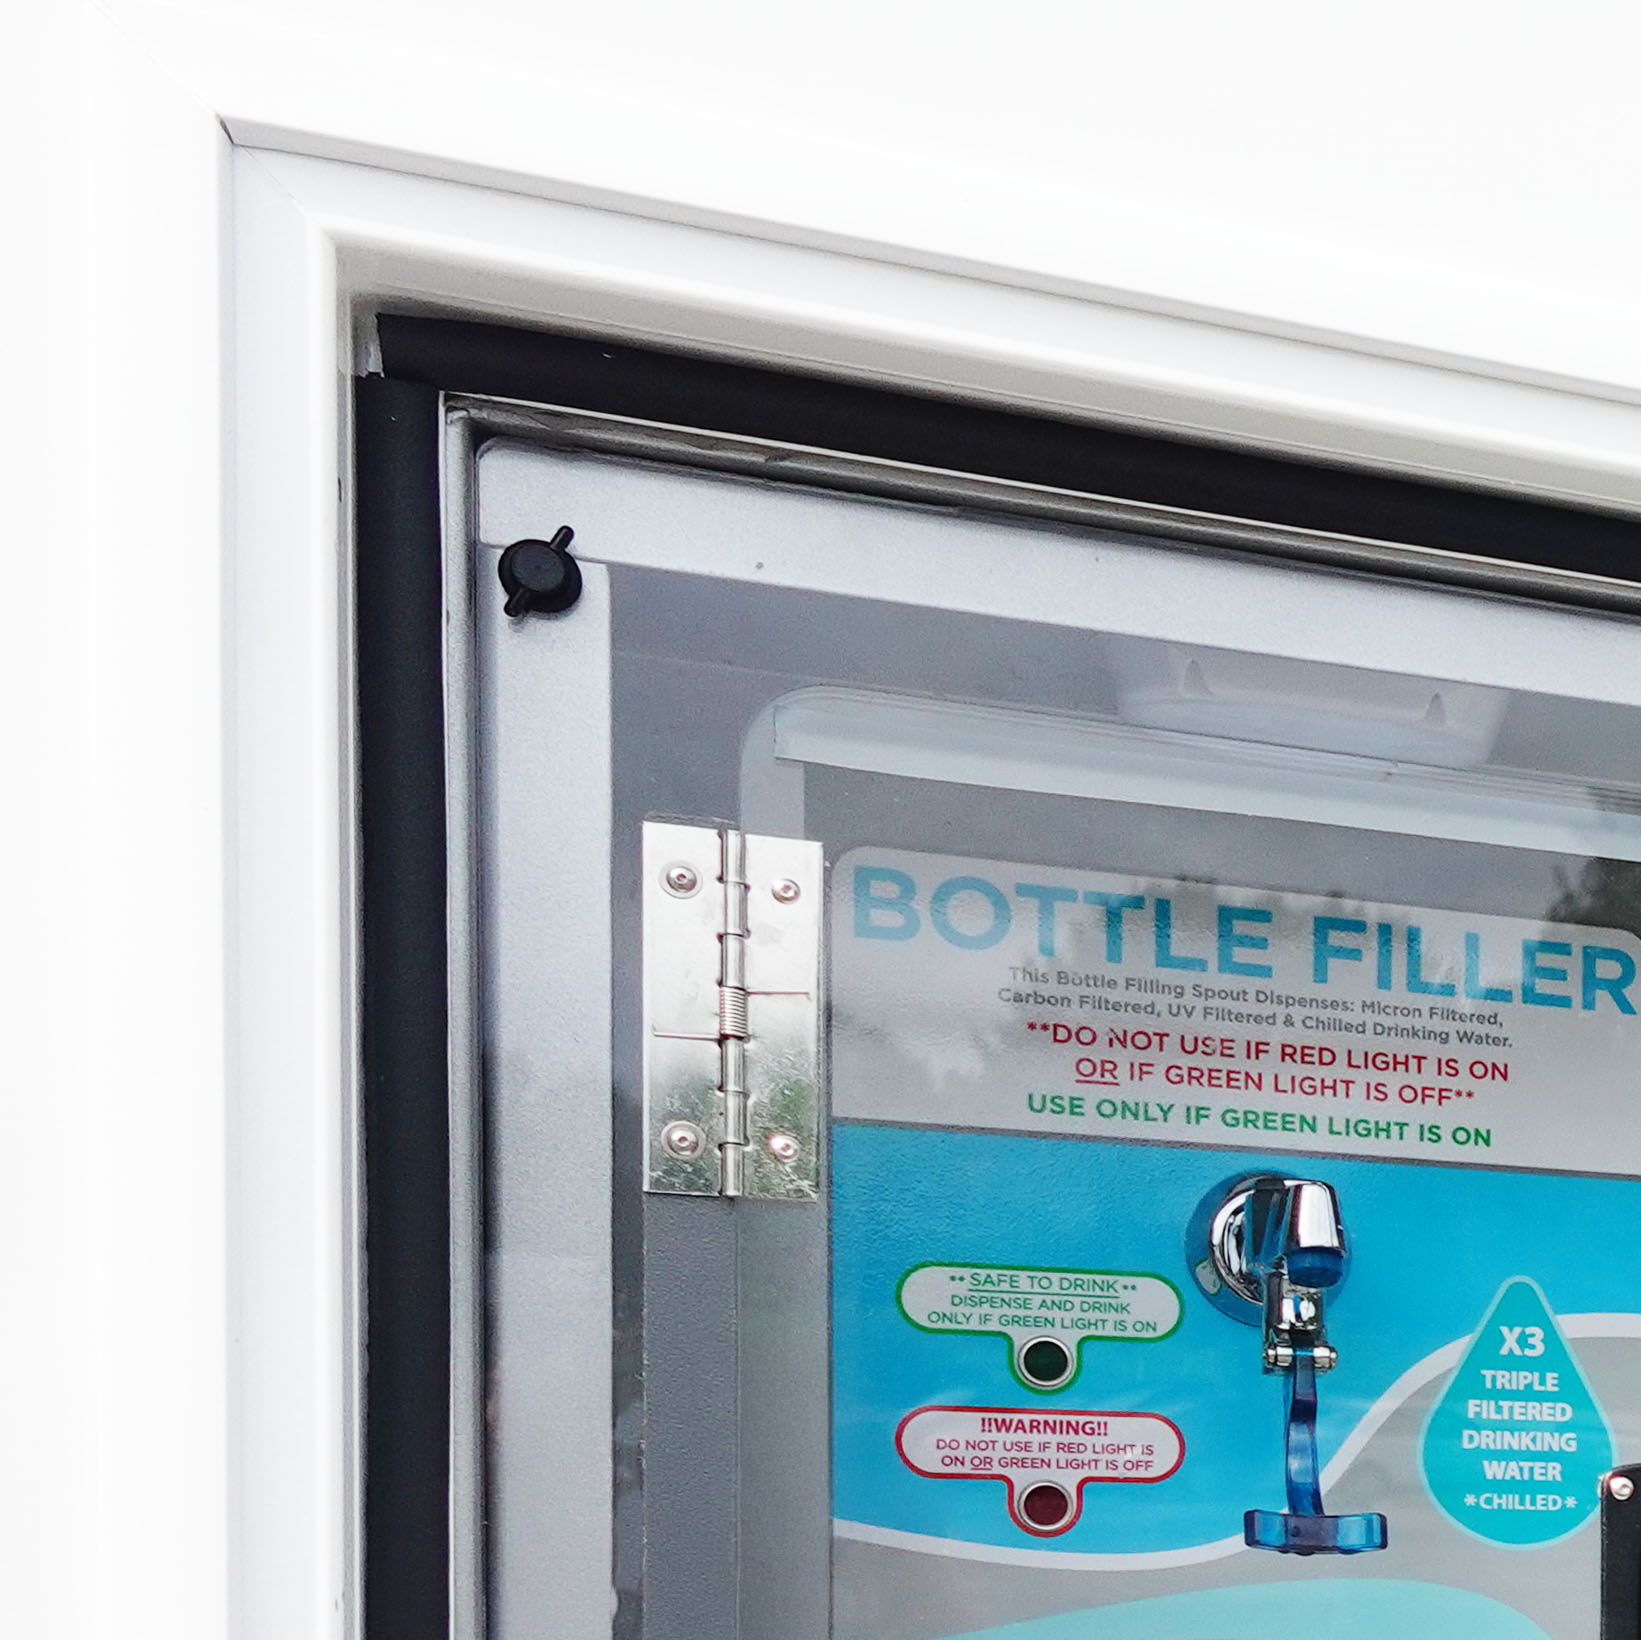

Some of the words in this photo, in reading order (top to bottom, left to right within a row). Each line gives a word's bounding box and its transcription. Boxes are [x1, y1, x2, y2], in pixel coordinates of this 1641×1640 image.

[853, 864, 1272, 978] BOTTLE
[1313, 915, 1636, 1015] FILLER
[1010, 966, 1049, 984] This
[1057, 971, 1117, 990] Bottle
[1126, 977, 1184, 999] Filling
[1191, 983, 1248, 1005] Spout
[1255, 990, 1354, 1015] Dispenses:
[1361, 999, 1422, 1018] Micron
[1429, 1006, 1503, 1028] Filtered,
[998, 987, 1071, 1008] Carbon
[1079, 995, 1161, 1018] Filtered,
[1168, 1003, 1196, 1019] UV
[1203, 1006, 1276, 1026] Filtered
[1283, 1013, 1294, 1028] &
[1302, 1015, 1366, 1034] Chilled
[1373, 1021, 1449, 1044] Drinking
[1456, 1029, 1512, 1047] Water.
[1108, 1028, 1169, 1053] NOT
[1180, 1034, 1235, 1059] USE
[1246, 1040, 1269, 1062] IF
[1280, 1043, 1336, 1067] RED
[1347, 1048, 1427, 1075] LIGHT
[1437, 1056, 1459, 1077] IS
[1469, 1059, 1508, 1081] ON
[1075, 1057, 1119, 1086] OR
[1130, 1061, 1154, 1083] IF
[1165, 1064, 1262, 1092] GREEN
[1275, 1073, 1354, 1099] LIGHT
[1366, 1080, 1388, 1102] IS
[1028, 1093, 1085, 1117] USE
[1096, 1098, 1175, 1124] ONLY
[1185, 1105, 1211, 1127] IF
[1221, 1107, 1316, 1134] GREEN
[1328, 1116, 1409, 1141] LIGHT
[1419, 1122, 1441, 1143] IS
[1452, 1125, 1490, 1147] ON
[1027, 1274, 1052, 1291] TO
[951, 1294, 1032, 1310] DISPENSE
[1038, 1298, 1073, 1312] AND
[1080, 1300, 1130, 1314] DRINK
[927, 1311, 973, 1325] ONLY
[979, 1313, 993, 1326] IF
[998, 1314, 1055, 1329] GREEN
[1061, 1317, 1107, 1331] LIGHT
[1113, 1319, 1127, 1332] IS
[1132, 1320, 1157, 1333] ON
[1499, 1325, 1544, 1357] X3
[1481, 1369, 1559, 1392] TRIPLE
[1467, 1400, 1572, 1422] FILTERED
[981, 1417, 1108, 1436] !!WARNING!!
[936, 1439, 959, 1451] DO
[965, 1440, 997, 1452] NOT
[1003, 1440, 1031, 1453] USE
[1038, 1441, 1051, 1453] IF
[1056, 1442, 1087, 1454] RED
[1092, 1443, 1136, 1455] LIGHT
[1141, 1444, 1153, 1456] IS
[1462, 1430, 1577, 1452] DRINKING
[941, 1454, 964, 1467] ON
[970, 1455, 992, 1471] OR
[999, 1456, 1051, 1469] GREEN
[1056, 1457, 1100, 1470] LIGHT
[1105, 1458, 1117, 1470] IS
[1123, 1459, 1153, 1471] OFF
[1483, 1461, 1562, 1481] WATER
